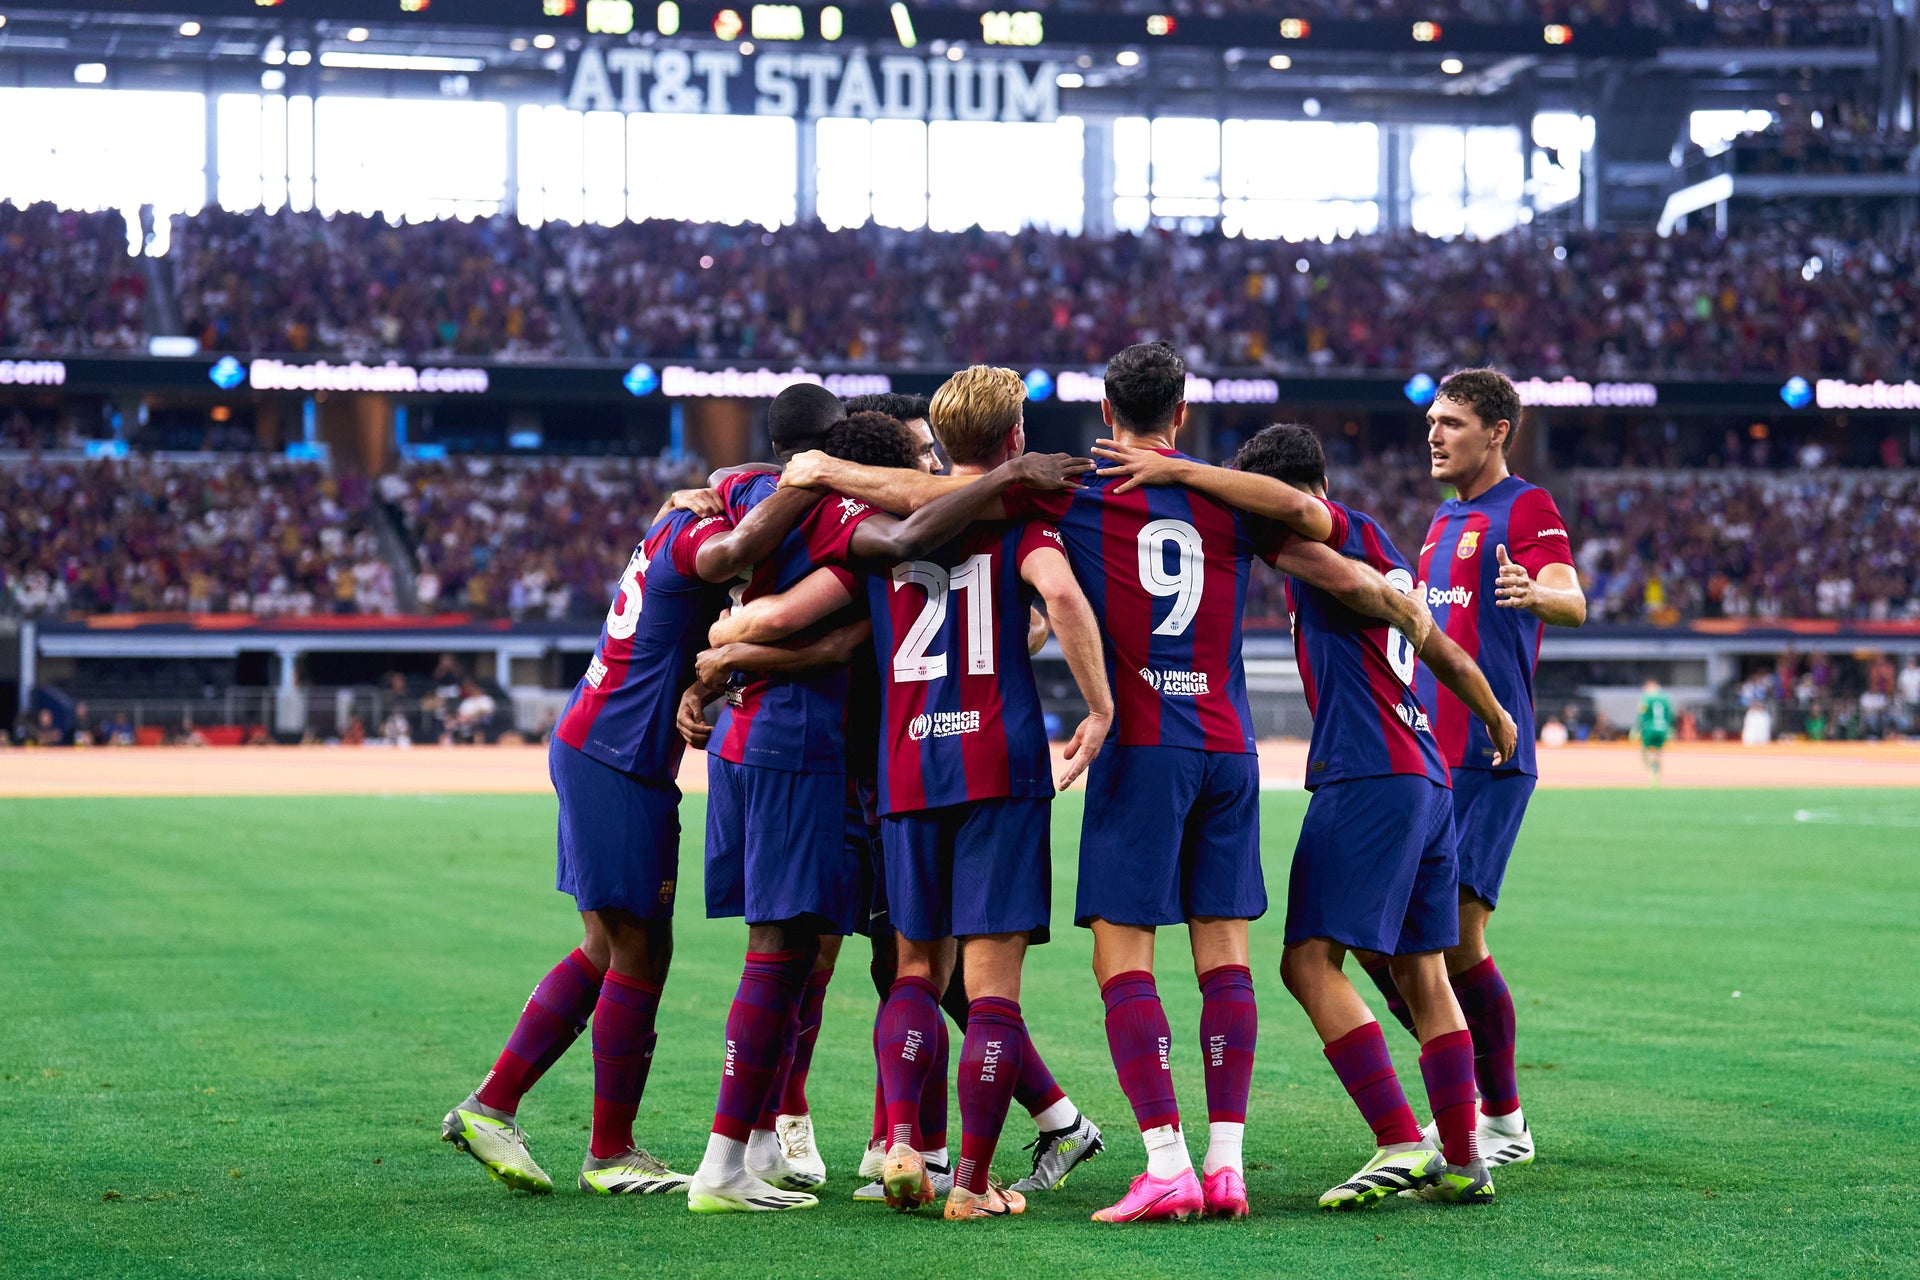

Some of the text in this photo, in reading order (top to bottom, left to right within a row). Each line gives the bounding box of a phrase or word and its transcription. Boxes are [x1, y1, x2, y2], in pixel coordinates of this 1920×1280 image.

[568, 47, 1062, 123] AT&T STADIUM
[1137, 519, 1204, 636] 9
[1428, 585, 1473, 608] Spotify
[891, 554, 995, 682] 21
[1163, 670, 1208, 683] UNHCR
[1163, 681, 1209, 692] ACNUR
[932, 720, 980, 733] ACNUR
[933, 710, 980, 723] UNHCR
[725, 1039, 737, 1076] BARÇA
[901, 1029, 923, 1061] BARÇA
[980, 1041, 1002, 1082] BARÇA
[1158, 1036, 1170, 1070] BARÇA
[1209, 1034, 1227, 1067] BARÇA
